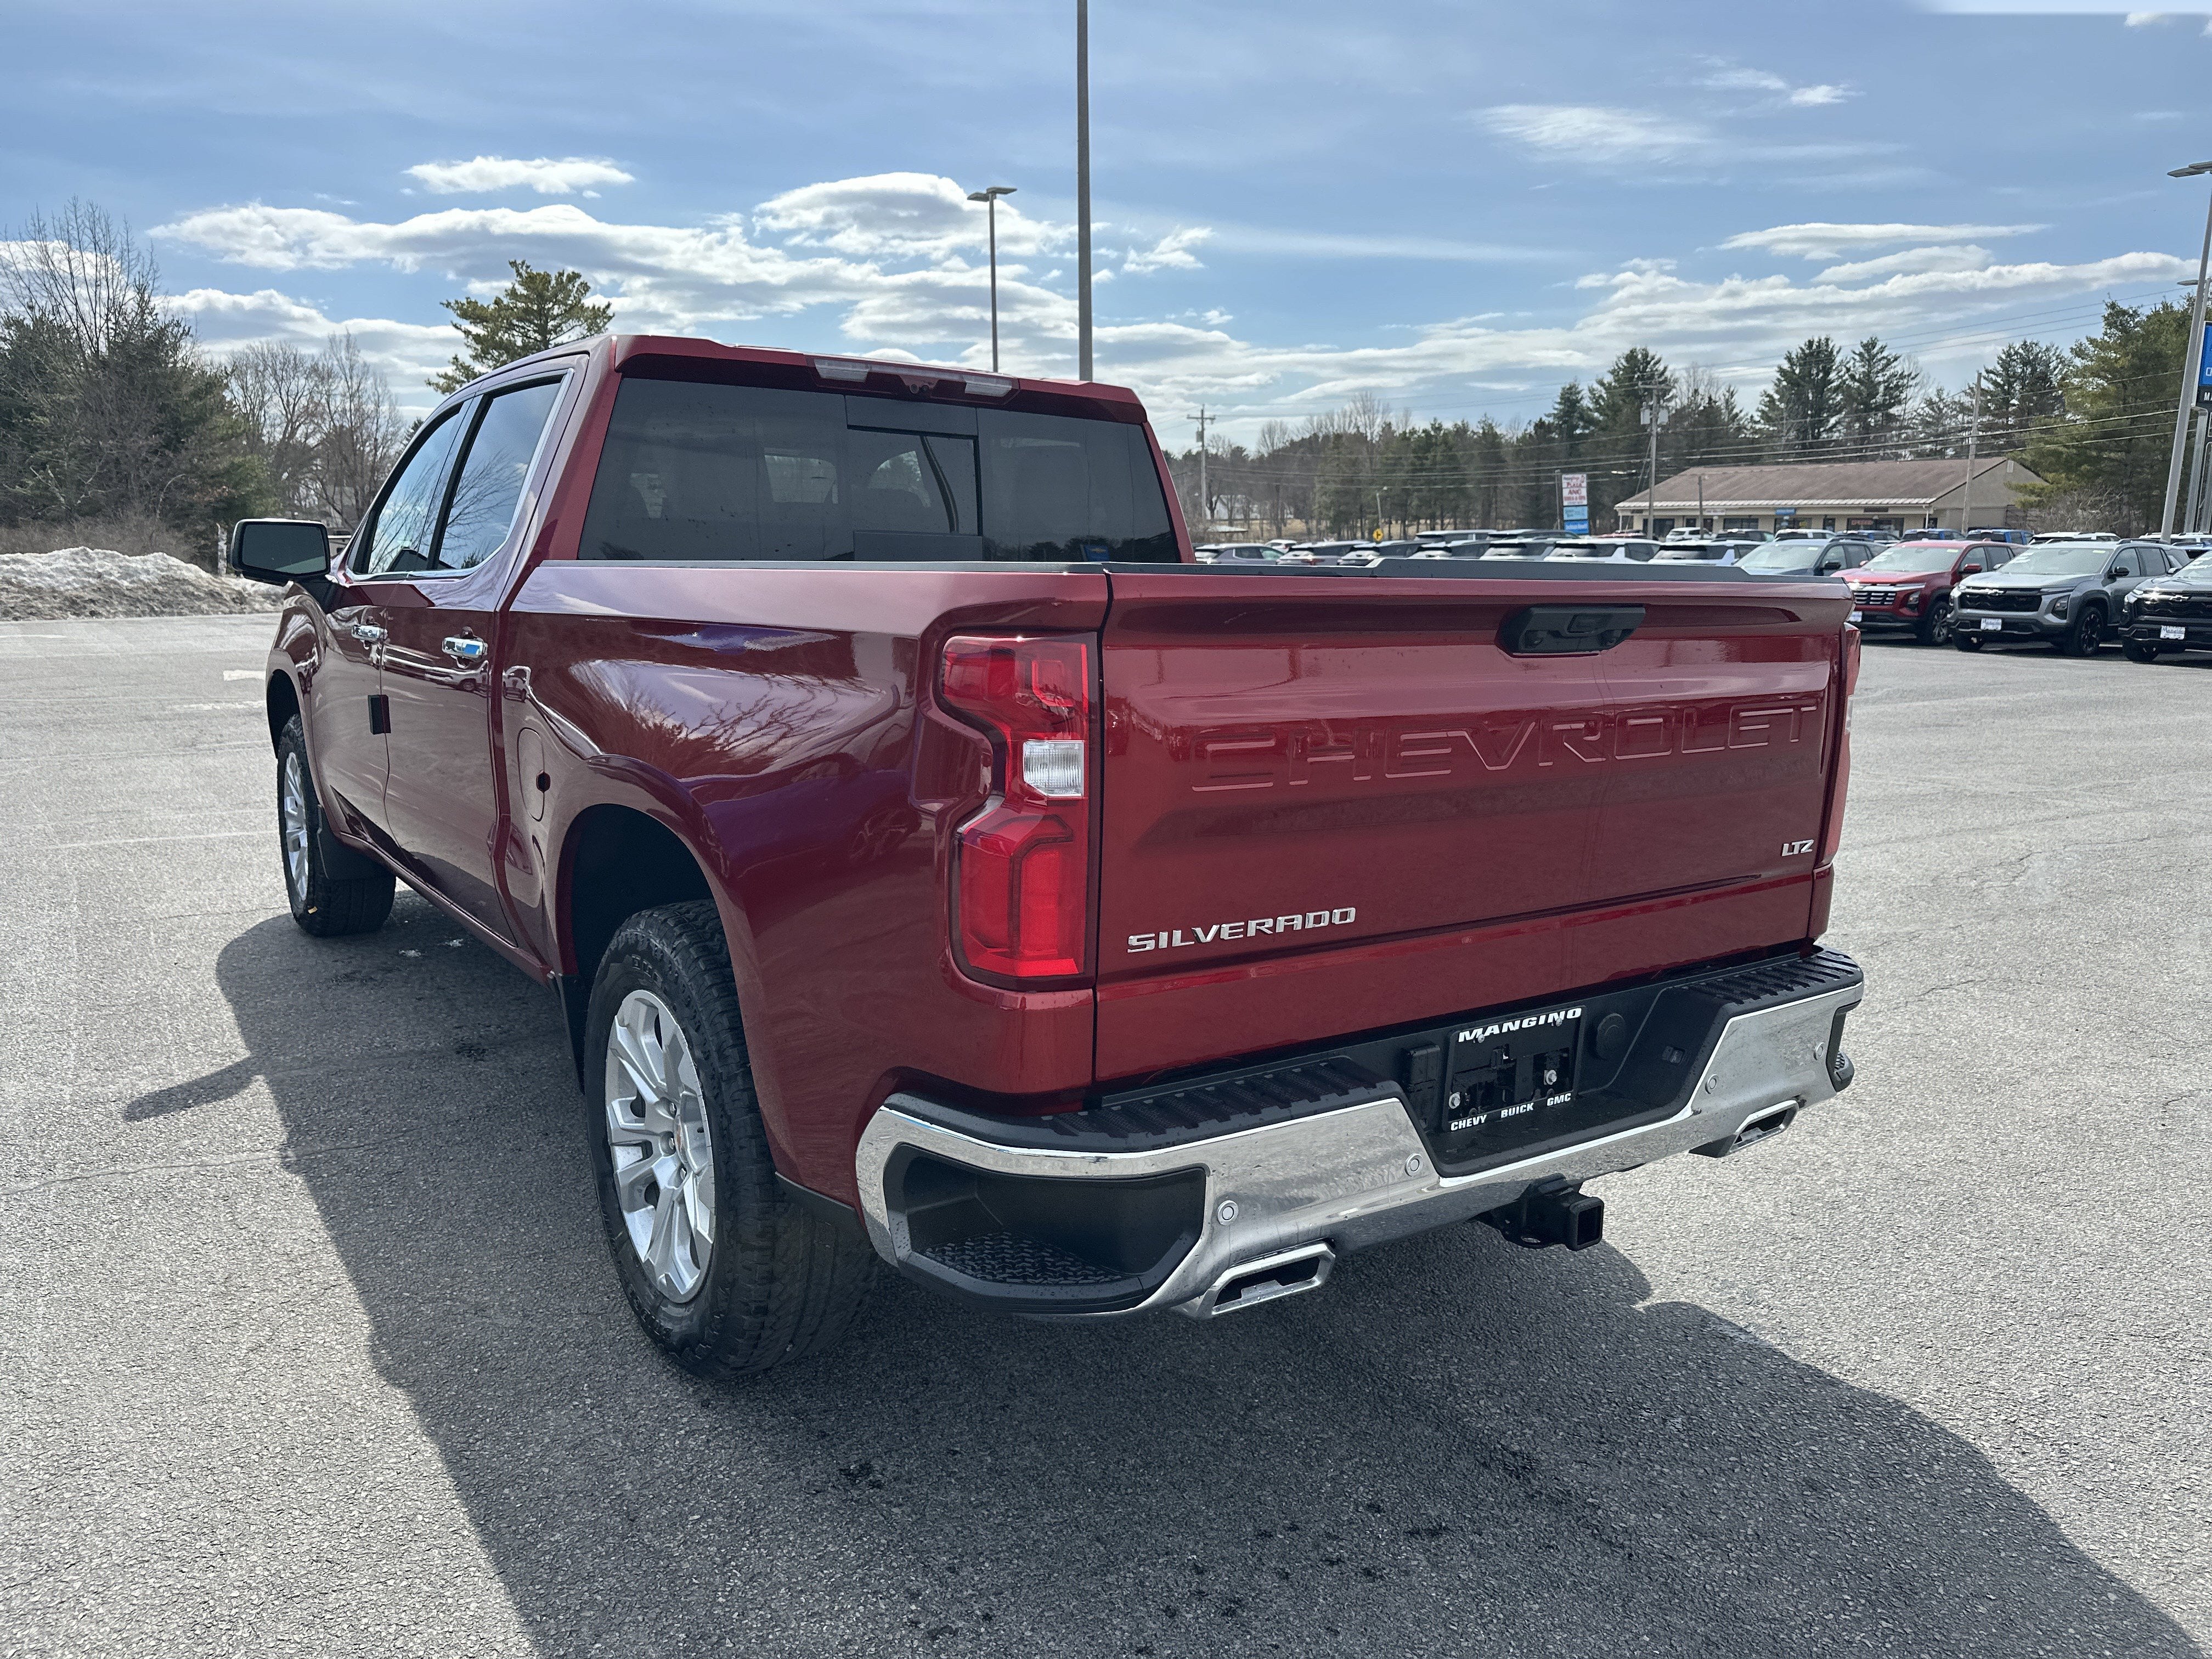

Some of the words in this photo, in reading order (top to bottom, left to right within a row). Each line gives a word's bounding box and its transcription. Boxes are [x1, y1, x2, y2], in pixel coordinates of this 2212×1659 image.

[1190, 698, 1818, 792] CHEVROLET
[1781, 839, 1814, 857] LTZ
[1127, 906, 1356, 953] SILVERADO
[1458, 1008, 1582, 1043] MANGINO
[1451, 1114, 1487, 1131] CHEVY
[1500, 1102, 1534, 1119] BUICK
[1547, 1093, 1571, 1107] GMC
